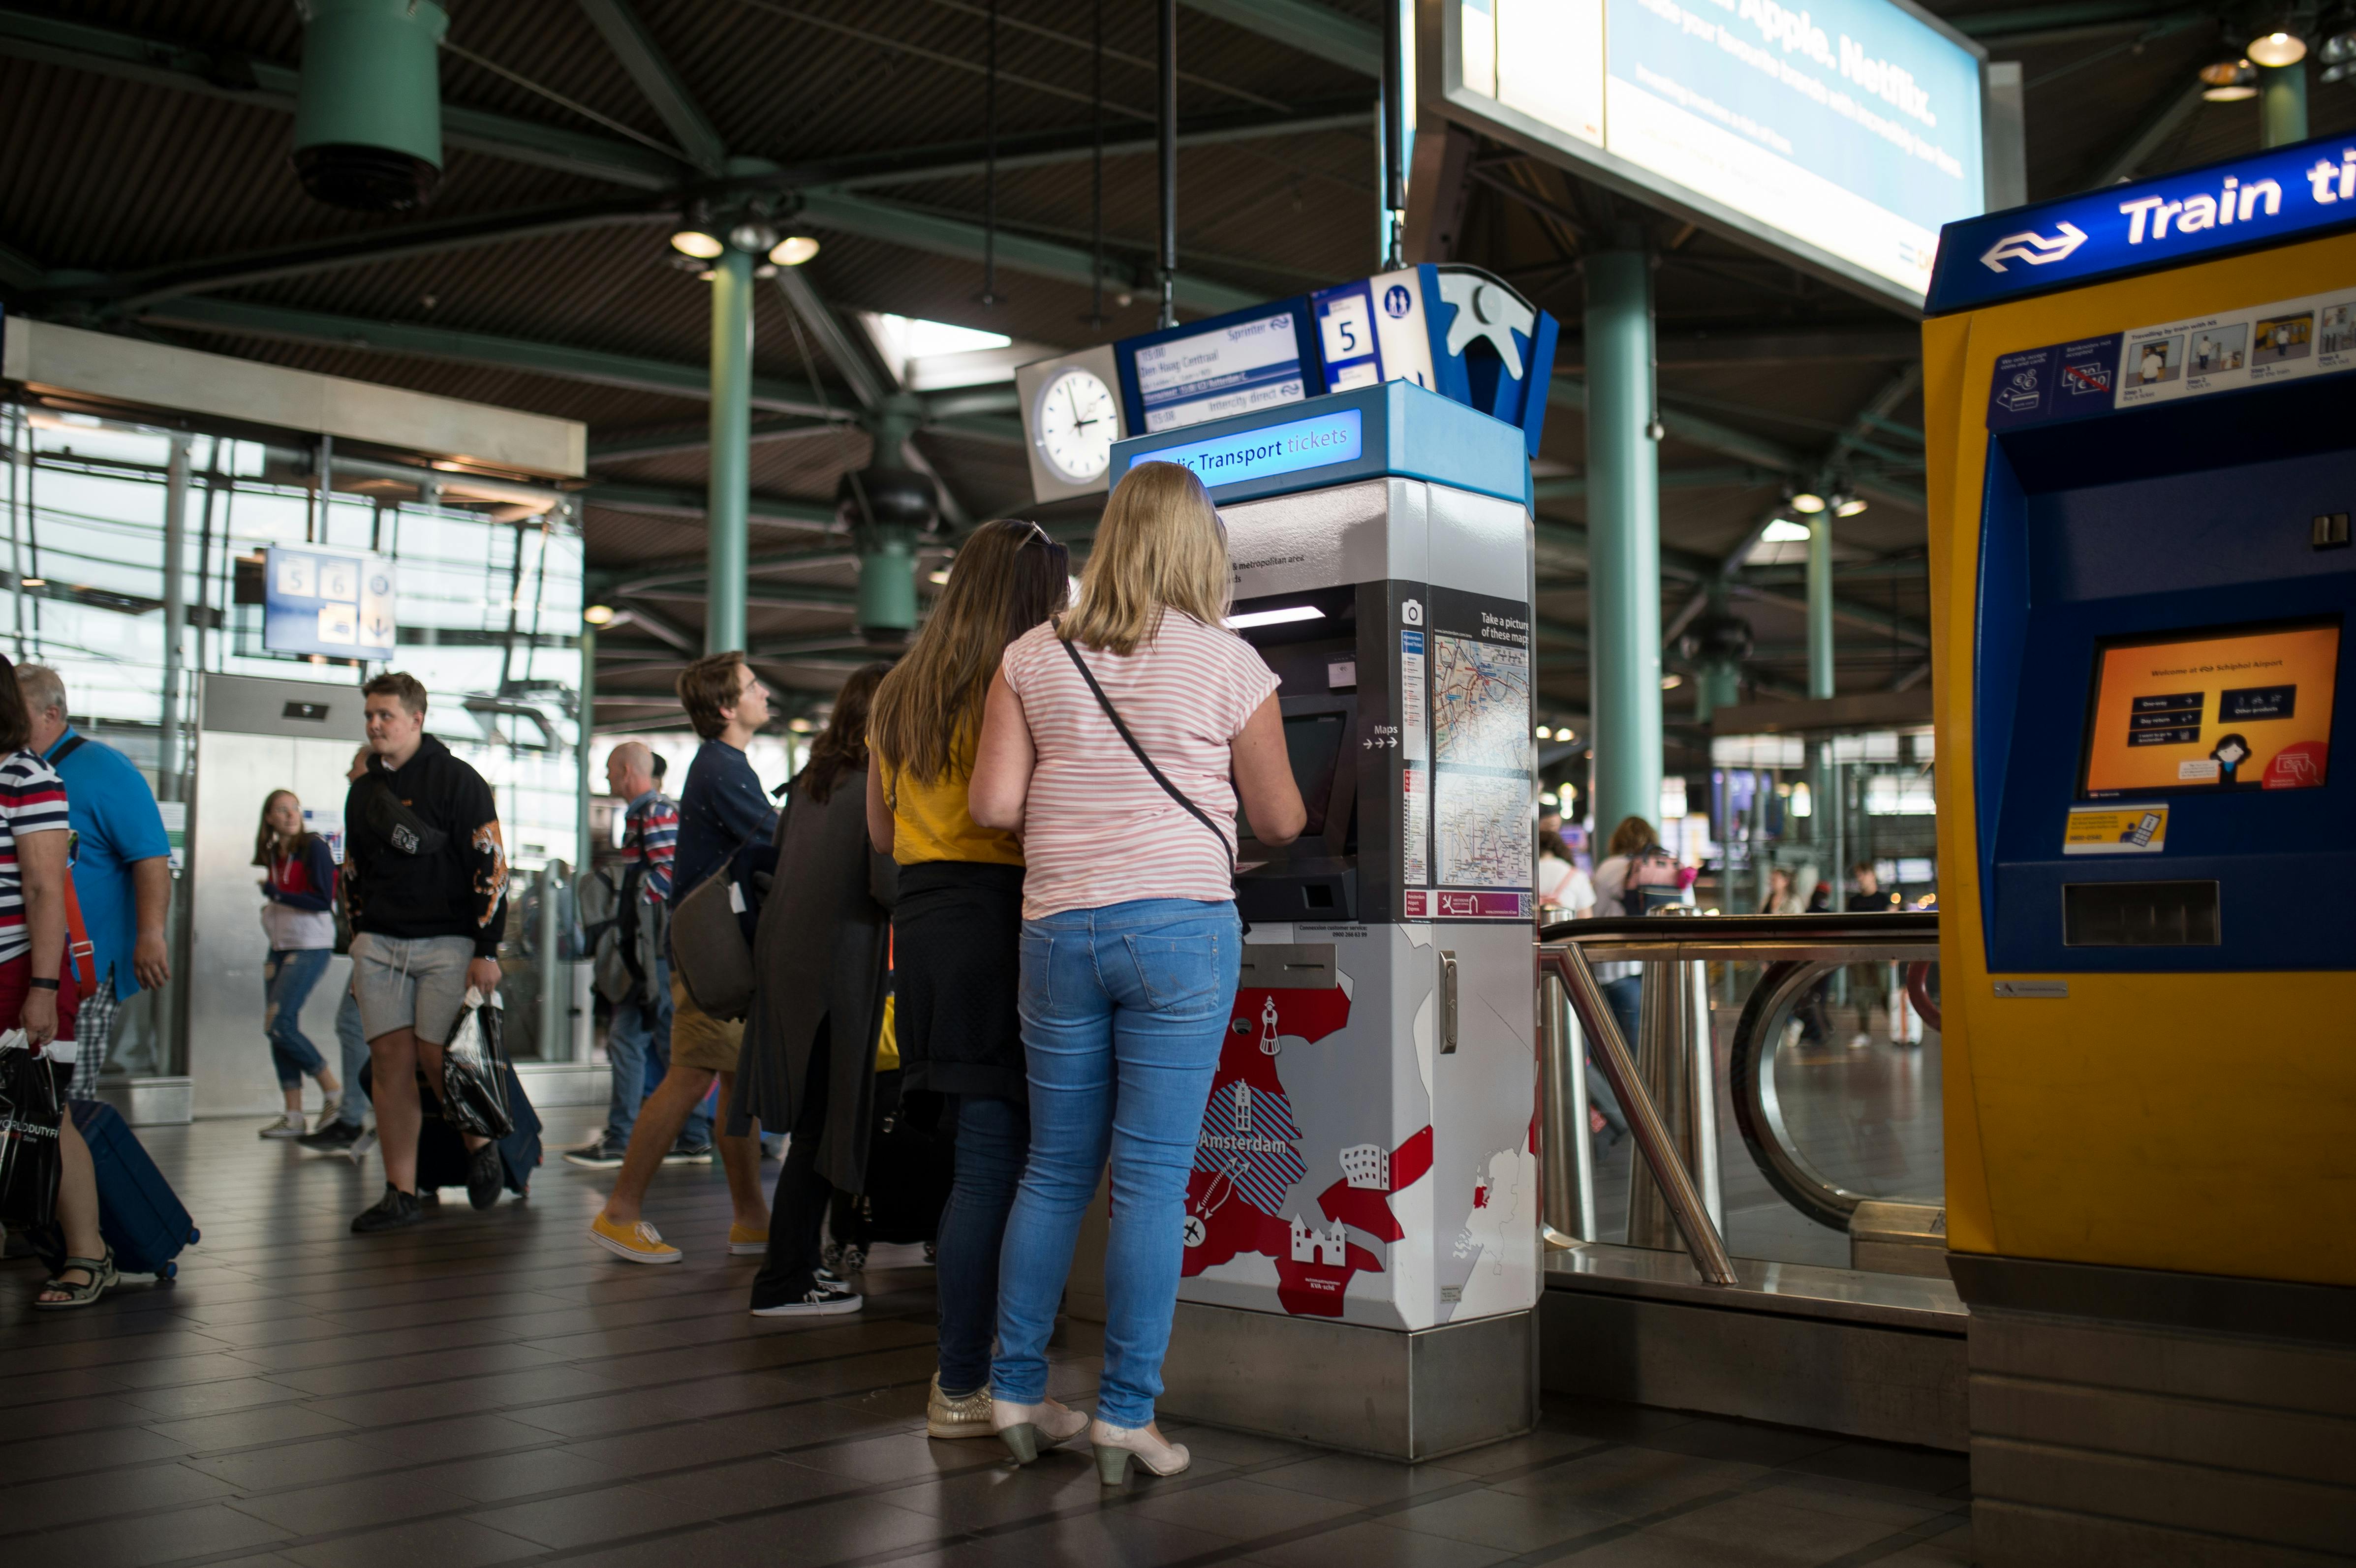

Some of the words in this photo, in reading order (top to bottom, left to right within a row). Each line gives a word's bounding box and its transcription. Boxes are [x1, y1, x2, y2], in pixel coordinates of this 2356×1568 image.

[1780, 59, 1828, 104] brands
[1839, 33, 1937, 127] Netflix.
[2119, 175, 2282, 245] Train
[1228, 324, 1266, 342] Sprinter
[1339, 321, 1356, 352] 5
[2131, 331, 2163, 340] Travelling
[2066, 348, 2093, 358] accepted
[2067, 343, 2099, 353] Banknotes
[1140, 365, 1155, 378] Den
[1160, 360, 1180, 374] Haag
[1183, 349, 1219, 367] Centraal
[1209, 396, 1247, 412] Intercity
[1250, 389, 1277, 404] direct
[1199, 441, 1282, 470] Transport
[1287, 429, 1347, 453] tickets
[1239, 556, 1288, 570] metropolitan
[1288, 554, 1305, 563] area
[290, 571, 303, 591] 5
[333, 575, 345, 594] 6
[1481, 612, 1498, 625] Take
[1500, 618, 1504, 626] a
[1505, 617, 1529, 631] picture
[1481, 627, 1490, 637] of
[1490, 627, 1510, 641] these
[1511, 634, 1529, 646] maps
[2151, 668, 2188, 677] Welcome
[2216, 662, 2252, 672] Schiphol
[2253, 659, 2283, 669] Airport
[1374, 725, 1398, 736] Maps
[1199, 1131, 1287, 1153] Amsterdam
